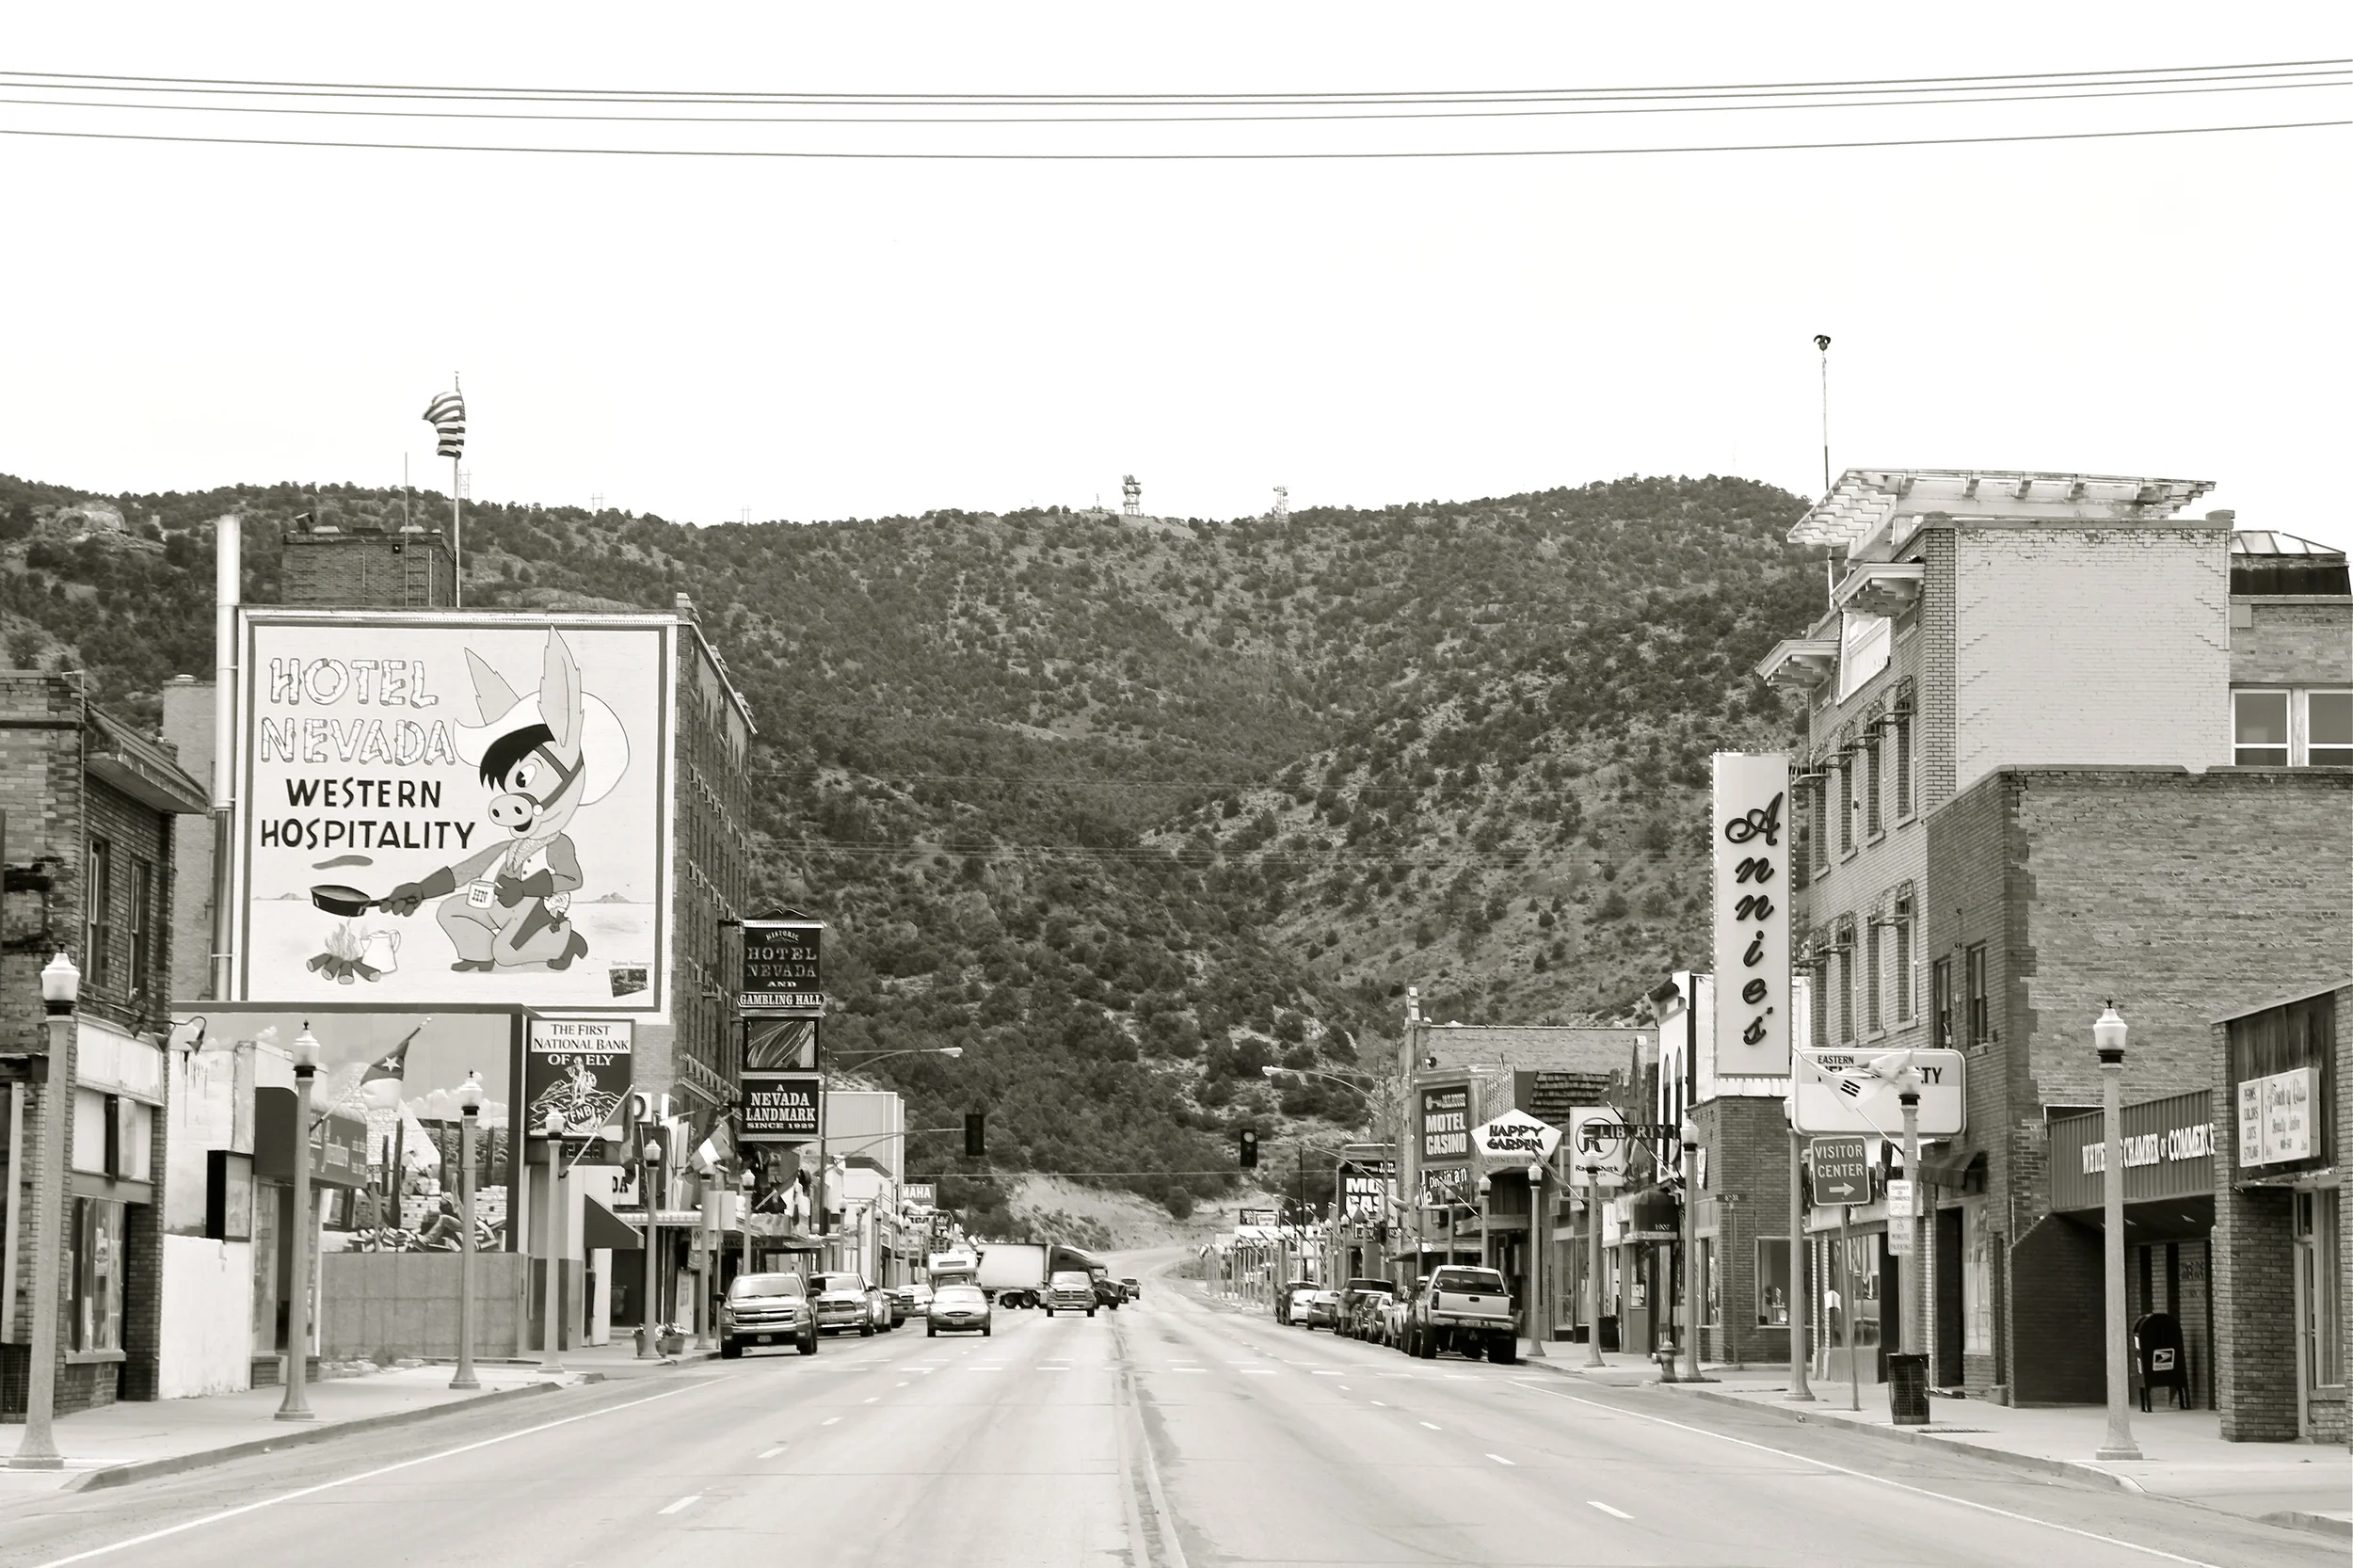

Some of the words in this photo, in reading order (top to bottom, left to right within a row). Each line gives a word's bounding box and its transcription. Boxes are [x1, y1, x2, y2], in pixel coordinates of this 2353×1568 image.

[269, 658, 440, 708] HOTEL
[261, 716, 456, 766] NEVADA
[285, 777, 441, 809] WESTERN
[261, 818, 475, 850] HOSPITALITY
[1724, 792, 1784, 1046] Annie's
[765, 930, 800, 942] HISTORIC
[746, 947, 817, 960] HOTEL
[746, 964, 817, 977] NEVADA
[740, 994, 793, 1005] GAMBLING
[795, 994, 822, 1005] HALL
[551, 1024, 576, 1035] THE
[578, 1024, 611, 1036] FIRST
[534, 1037, 594, 1050] NATIONAL
[596, 1039, 630, 1050] BANK
[547, 1054, 571, 1065] OF
[585, 1054, 614, 1065] ELY
[1817, 1055, 1854, 1064] EASTERN
[776, 1083, 785, 1092] A
[750, 1093, 810, 1106] NEVADA
[569, 1106, 593, 1123] FNB
[745, 1108, 816, 1122] LANDMARK
[1425, 1112, 1466, 1133] MOTEL
[1489, 1125, 1545, 1137] HAPPY
[1599, 1125, 1667, 1139] LIBRTY
[1426, 1133, 1467, 1156] CASINO
[1487, 1138, 1545, 1151] GARDEN
[2123, 1132, 2160, 1168] CHAMBER
[2168, 1122, 2217, 1162] COMMERCE
[1815, 1144, 1864, 1160] VISITOR
[1817, 1163, 1865, 1178] CENTER
